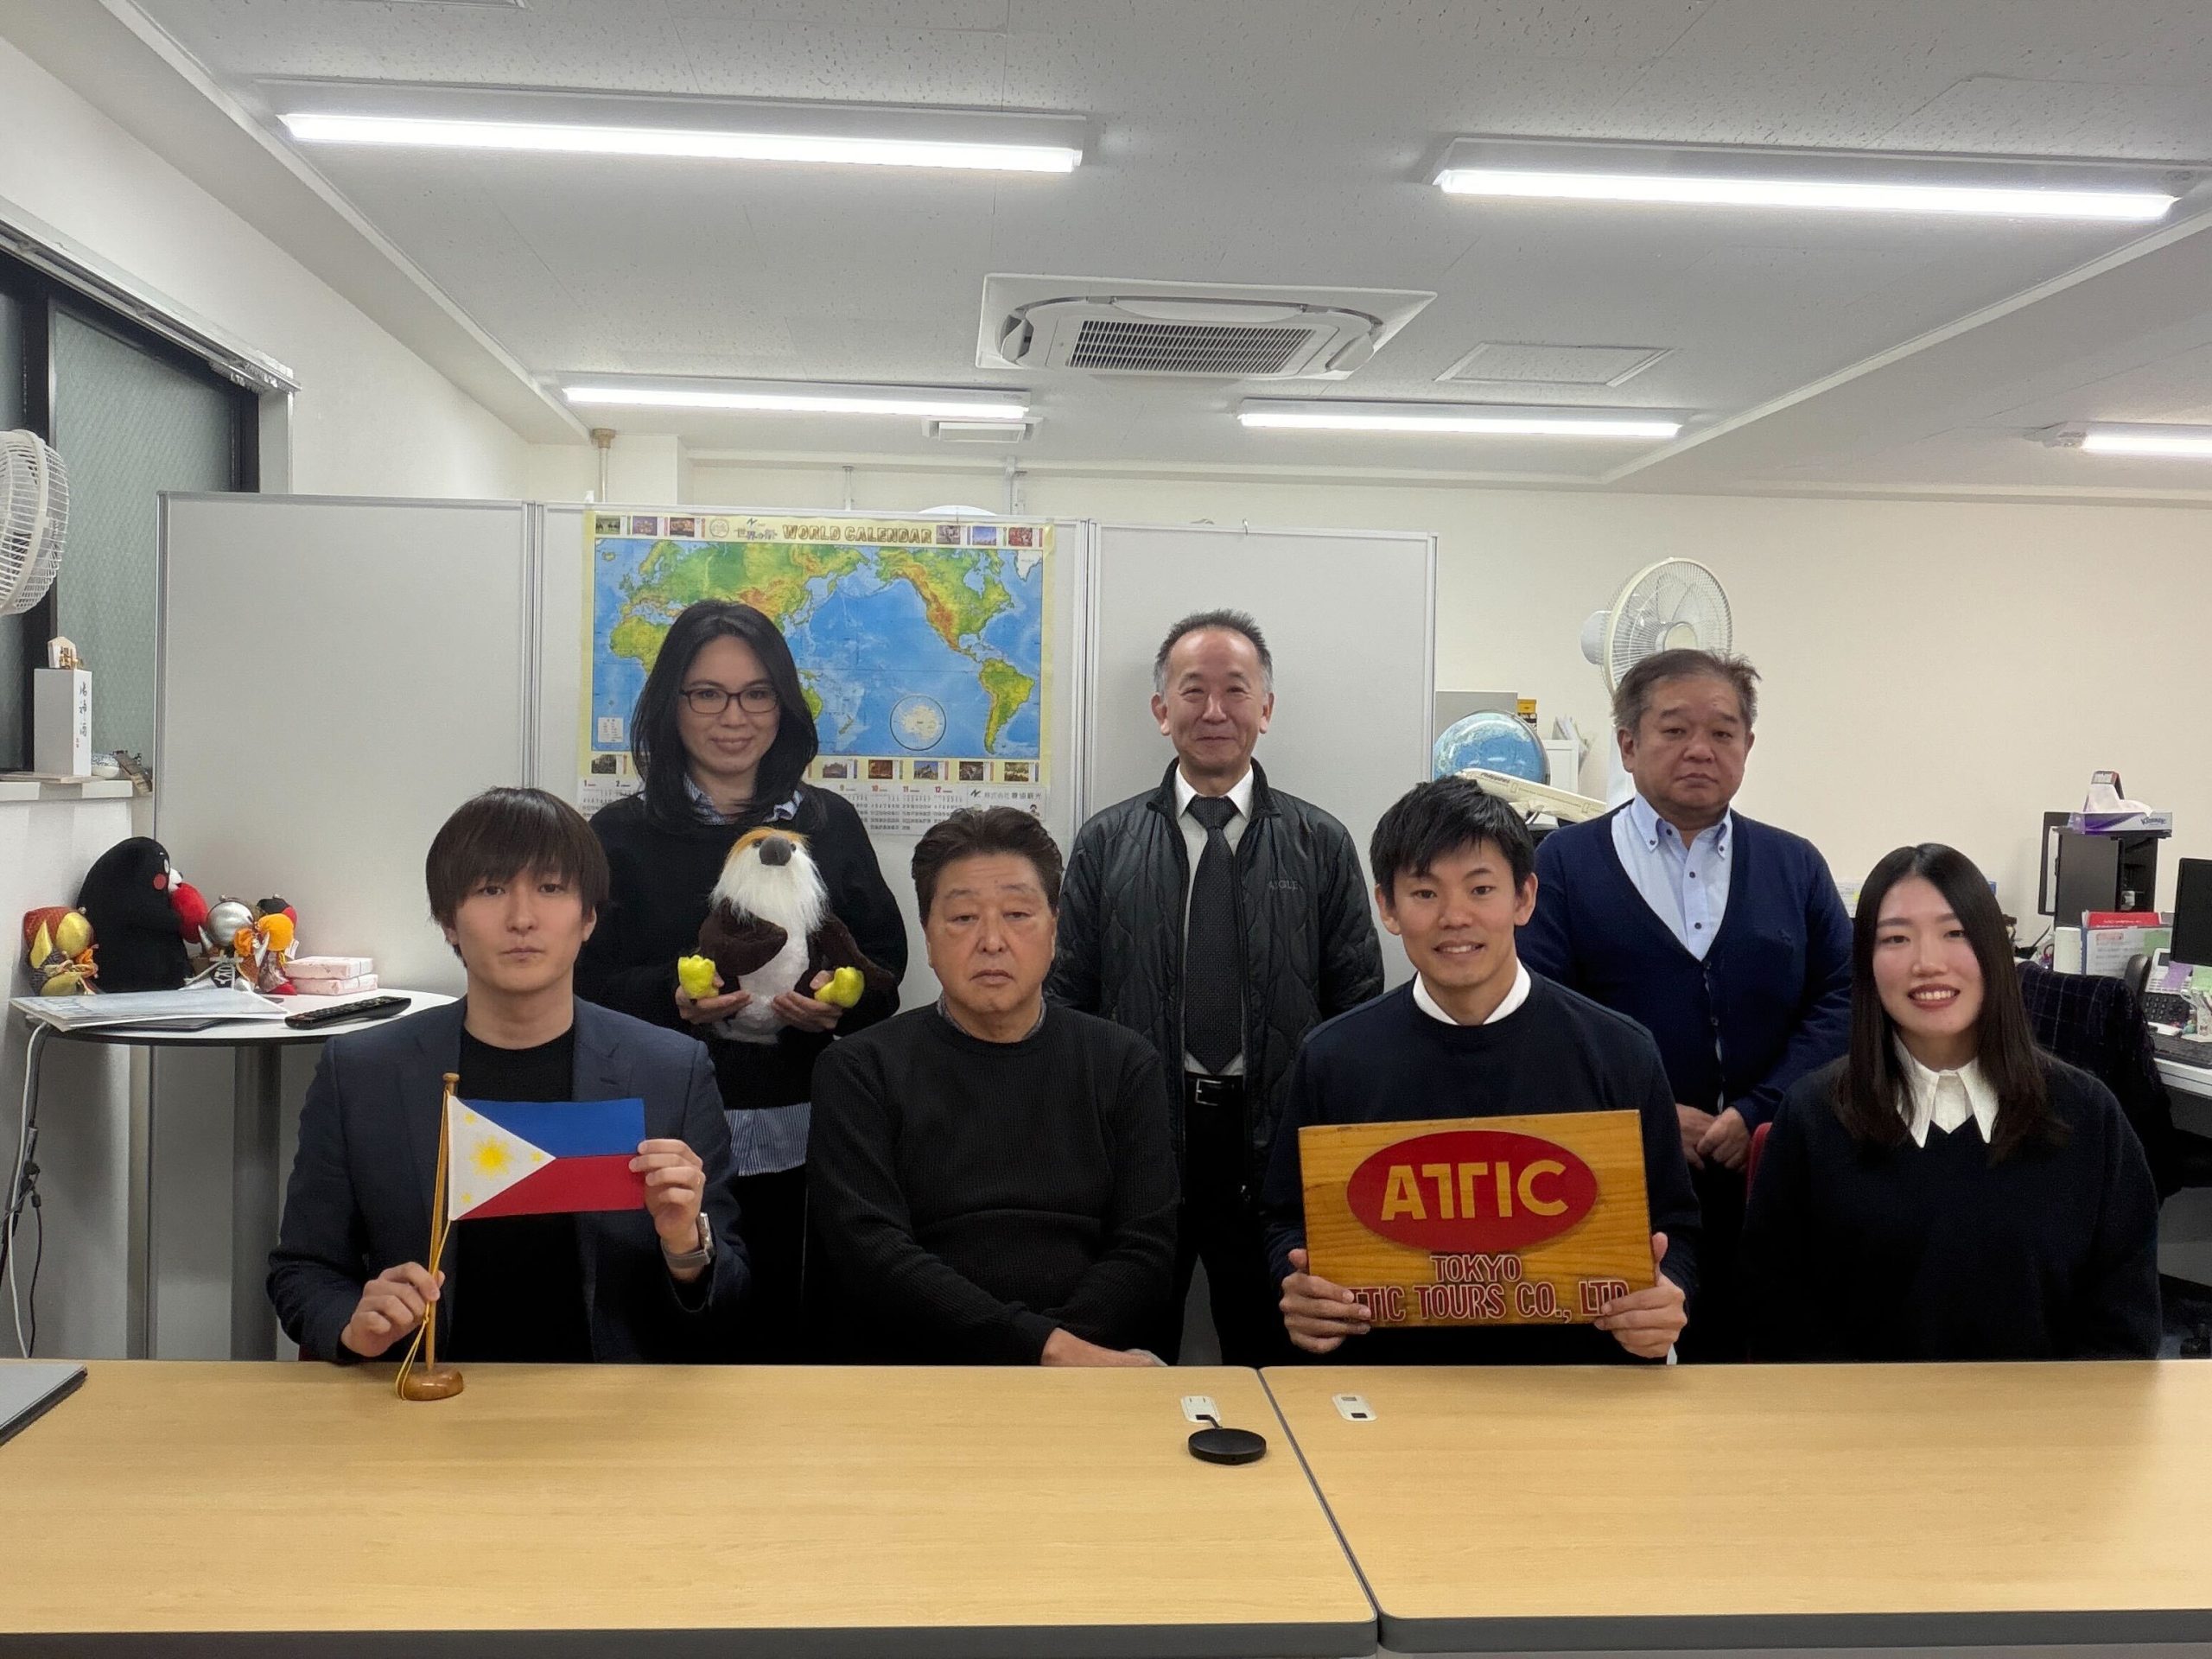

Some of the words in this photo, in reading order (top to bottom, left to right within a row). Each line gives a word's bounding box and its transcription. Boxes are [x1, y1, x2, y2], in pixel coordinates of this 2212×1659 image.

[782, 524, 842, 541] WORLD
[844, 527, 932, 543] CALENDAR
[1382, 1160, 1568, 1221] ATTIC
[1430, 1254, 1522, 1283] TOKYO
[1414, 1284, 1506, 1320] TOURS
[1515, 1283, 1572, 1323] CO.,
